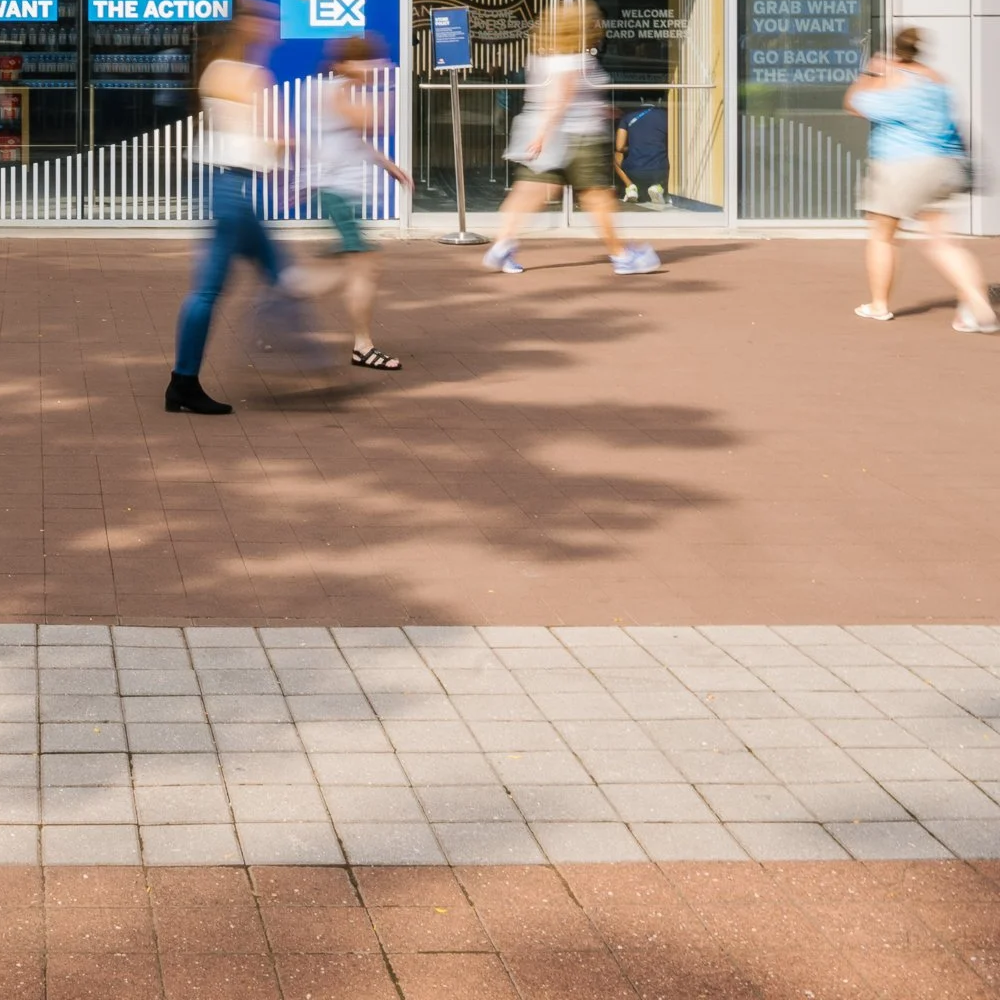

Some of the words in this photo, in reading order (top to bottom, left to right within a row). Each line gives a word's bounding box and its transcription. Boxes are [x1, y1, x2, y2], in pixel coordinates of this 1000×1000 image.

[93, 0, 139, 18] THE
[143, 0, 229, 19] ACTION
[621, 9, 674, 18] WELCOME
[753, 1, 802, 14] GRAB
[807, 1, 857, 14] WHAT
[753, 18, 790, 32] YOU
[794, 18, 846, 32] WANT
[605, 30, 635, 39] CARD
[753, 50, 779, 65] GO
[783, 50, 830, 65] BACK
[833, 50, 858, 64] TO
[752, 68, 787, 82] THE
[793, 68, 858, 83] ACTION
